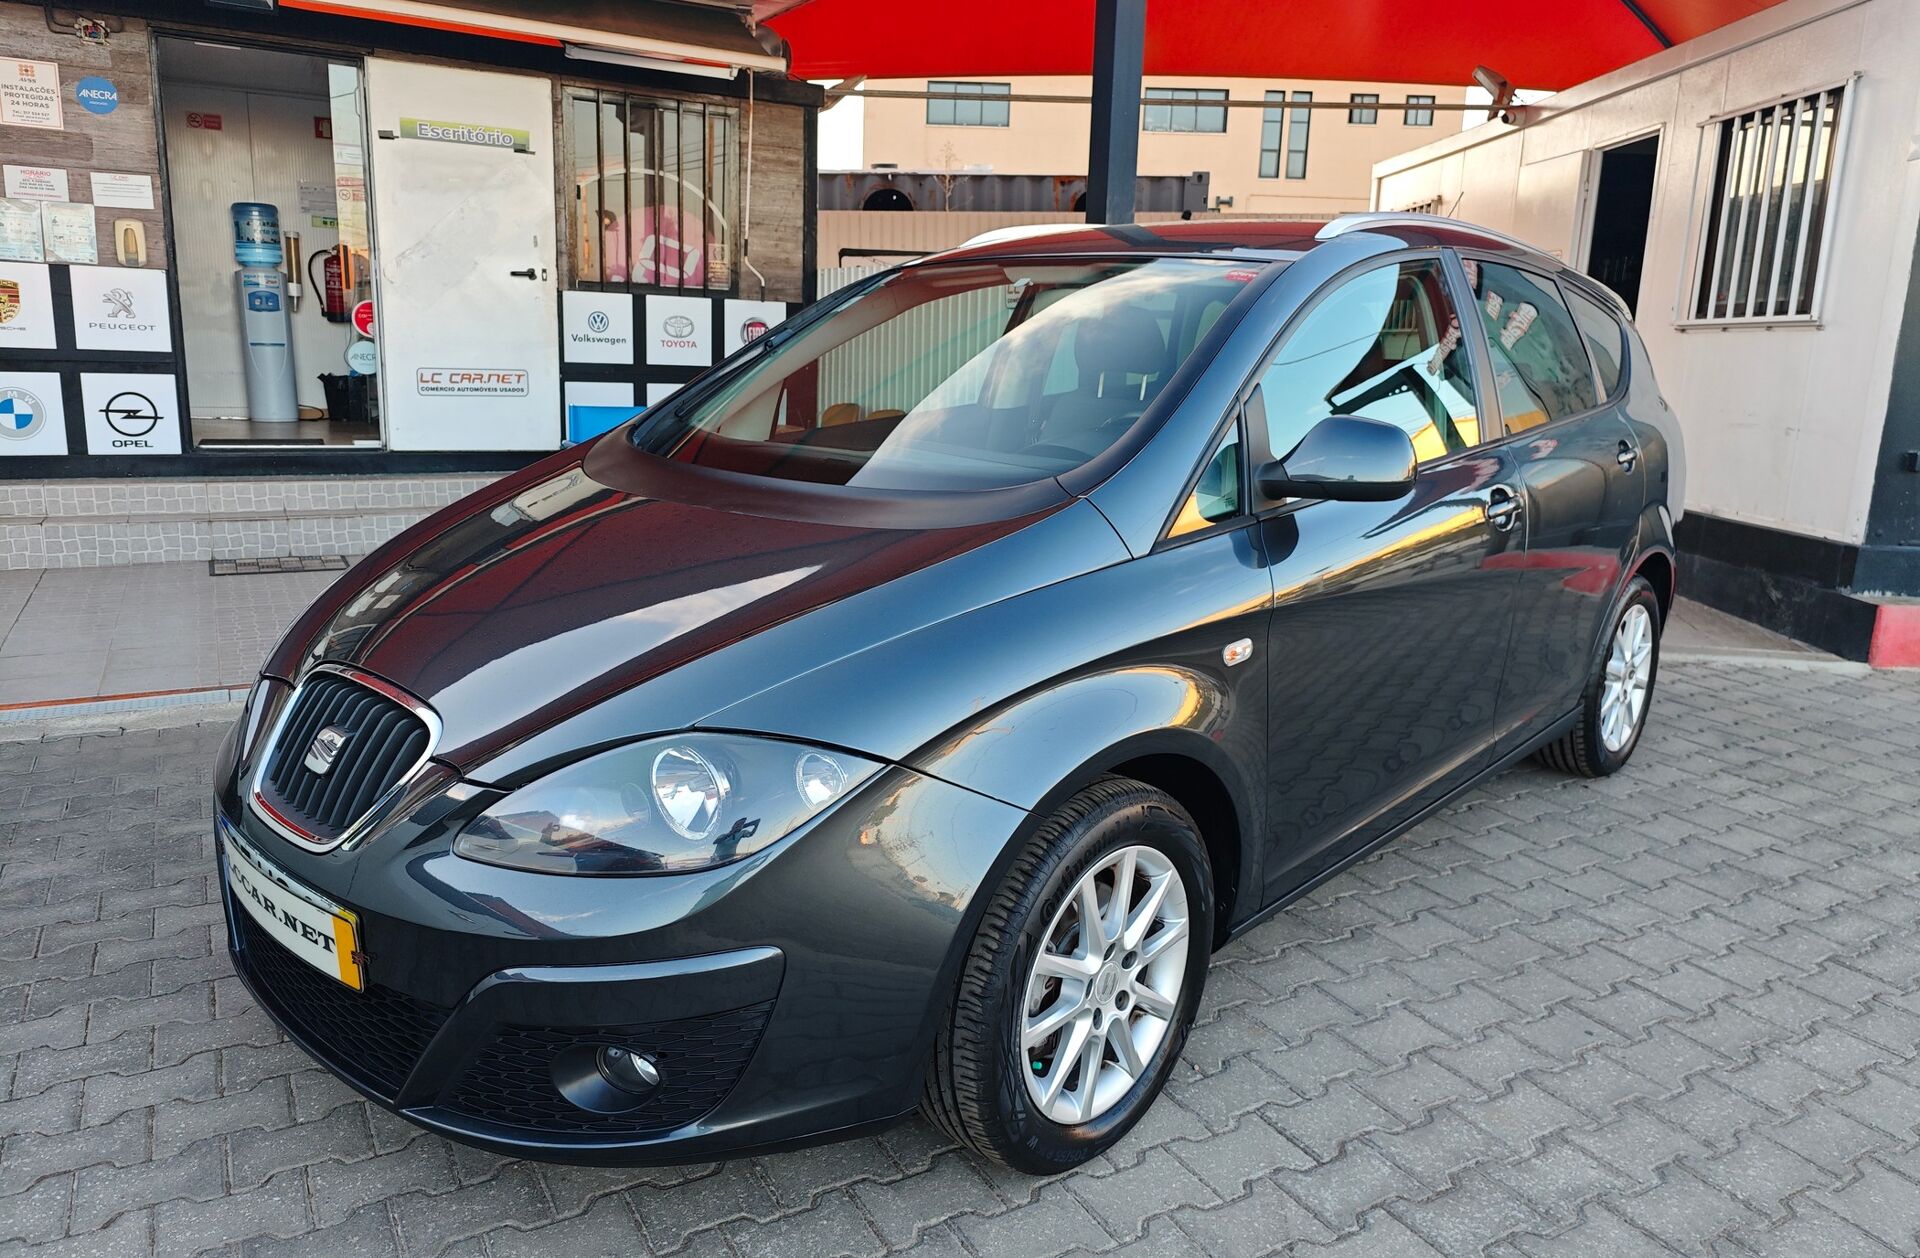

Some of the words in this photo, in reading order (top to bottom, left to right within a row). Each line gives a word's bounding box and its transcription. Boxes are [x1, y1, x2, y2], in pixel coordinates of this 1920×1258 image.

[1, 83, 56, 95] INSTALAÇÕES
[78, 88, 118, 101] ANECRA
[4, 91, 54, 102] PROTEGIDAS
[22, 101, 50, 109] HORAS
[417, 122, 513, 146] Escritório
[88, 322, 157, 332] PEUGEOT
[571, 333, 627, 345] Volkswagen
[661, 339, 697, 349] TOYOTA
[419, 372, 443, 384] LC
[449, 372, 526, 385] CAR.NET
[112, 439, 155, 449] OPEL
